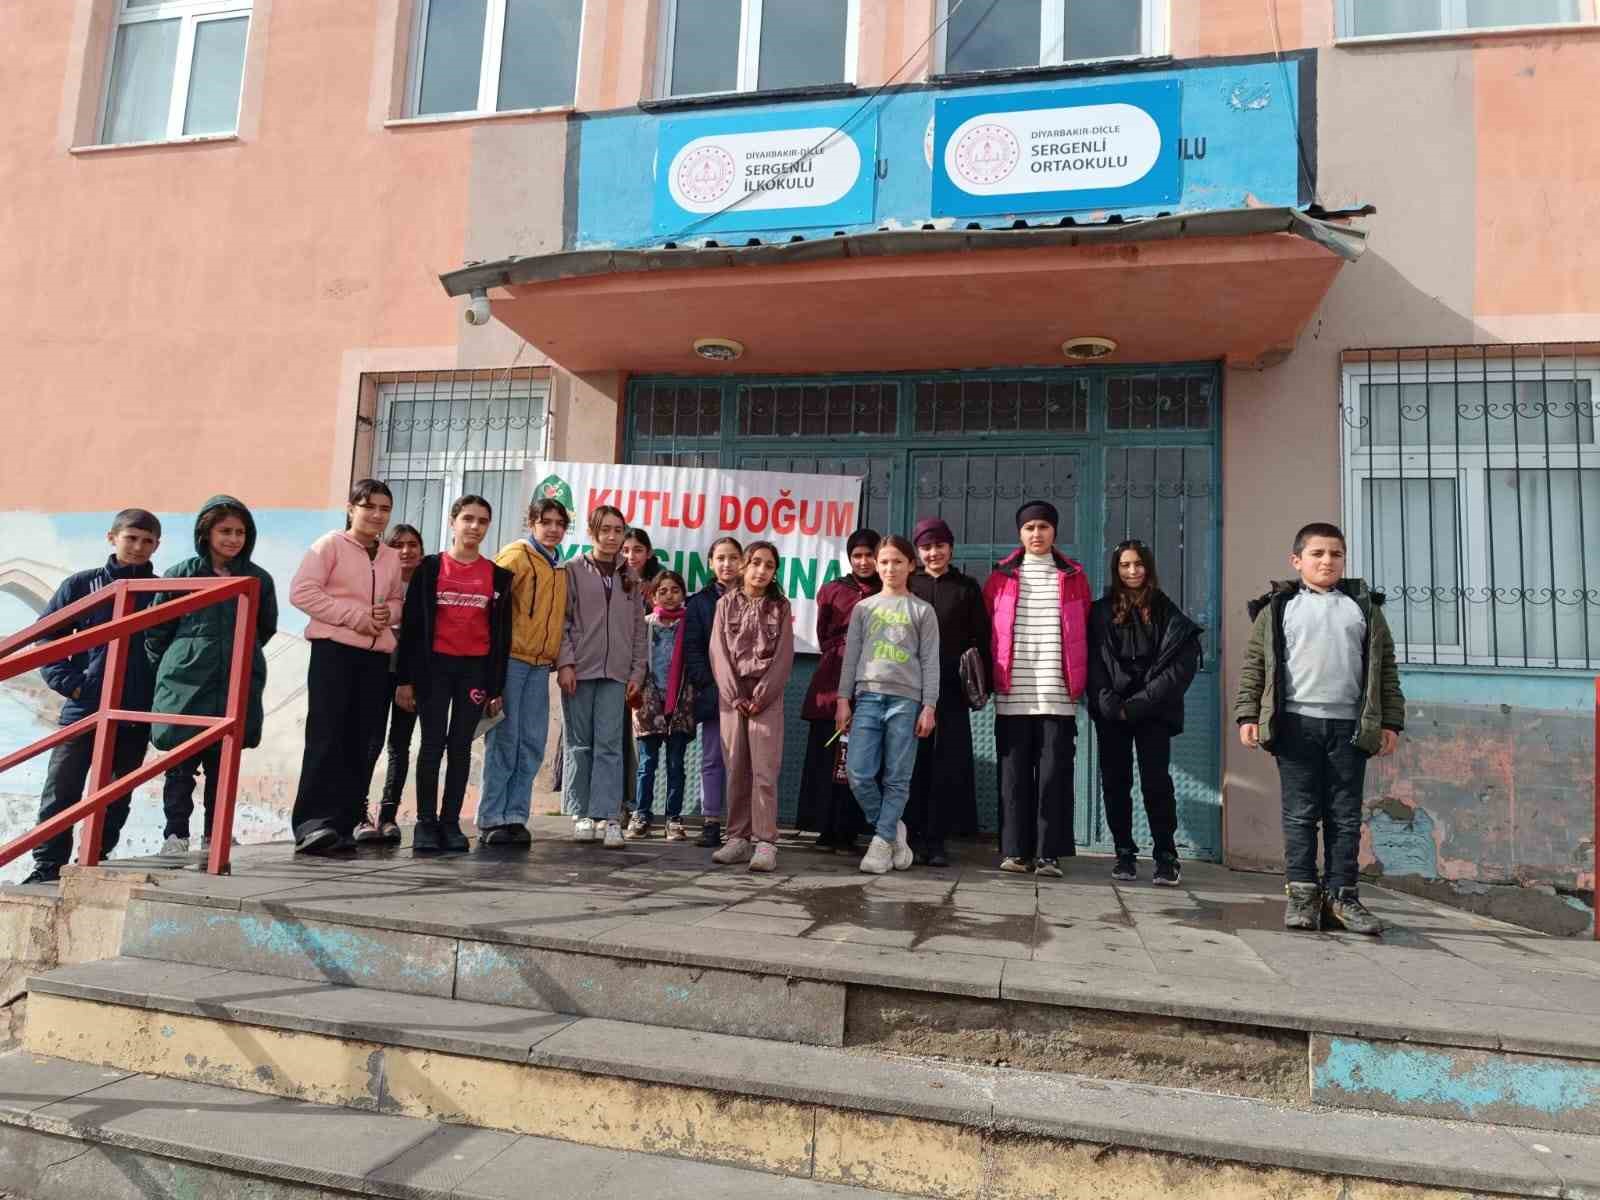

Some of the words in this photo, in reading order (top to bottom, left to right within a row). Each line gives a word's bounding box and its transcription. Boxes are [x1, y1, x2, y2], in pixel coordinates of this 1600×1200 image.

[1031, 137, 1106, 157] SERGENLİ
[745, 158, 813, 177] SERGENLİ
[1030, 154, 1128, 173] ORTAOKULU
[744, 176, 815, 192] İLKOKULU
[719, 488, 855, 537] DOĞUM
